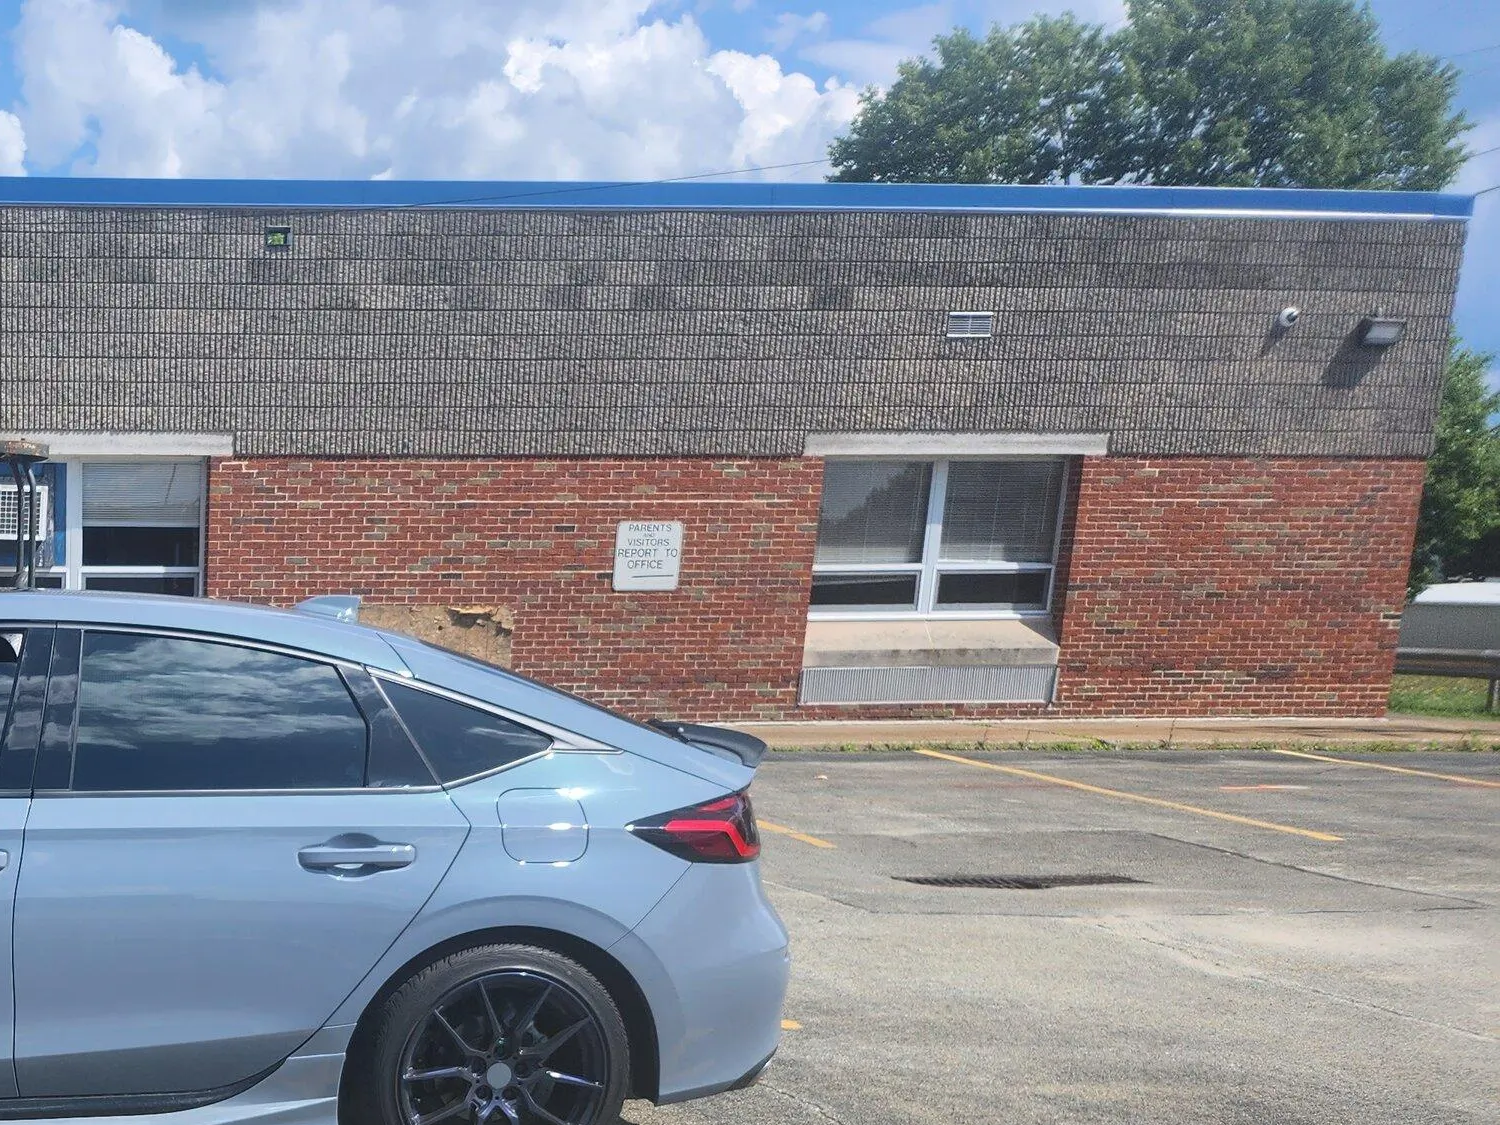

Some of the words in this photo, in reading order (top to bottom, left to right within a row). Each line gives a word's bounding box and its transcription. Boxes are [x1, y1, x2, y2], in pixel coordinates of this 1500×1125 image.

[629, 523, 672, 532] PARENTS
[628, 538, 670, 546] VISITORS
[617, 548, 657, 558] REPORT
[666, 548, 678, 558] TO
[627, 559, 663, 569] OFFICE
